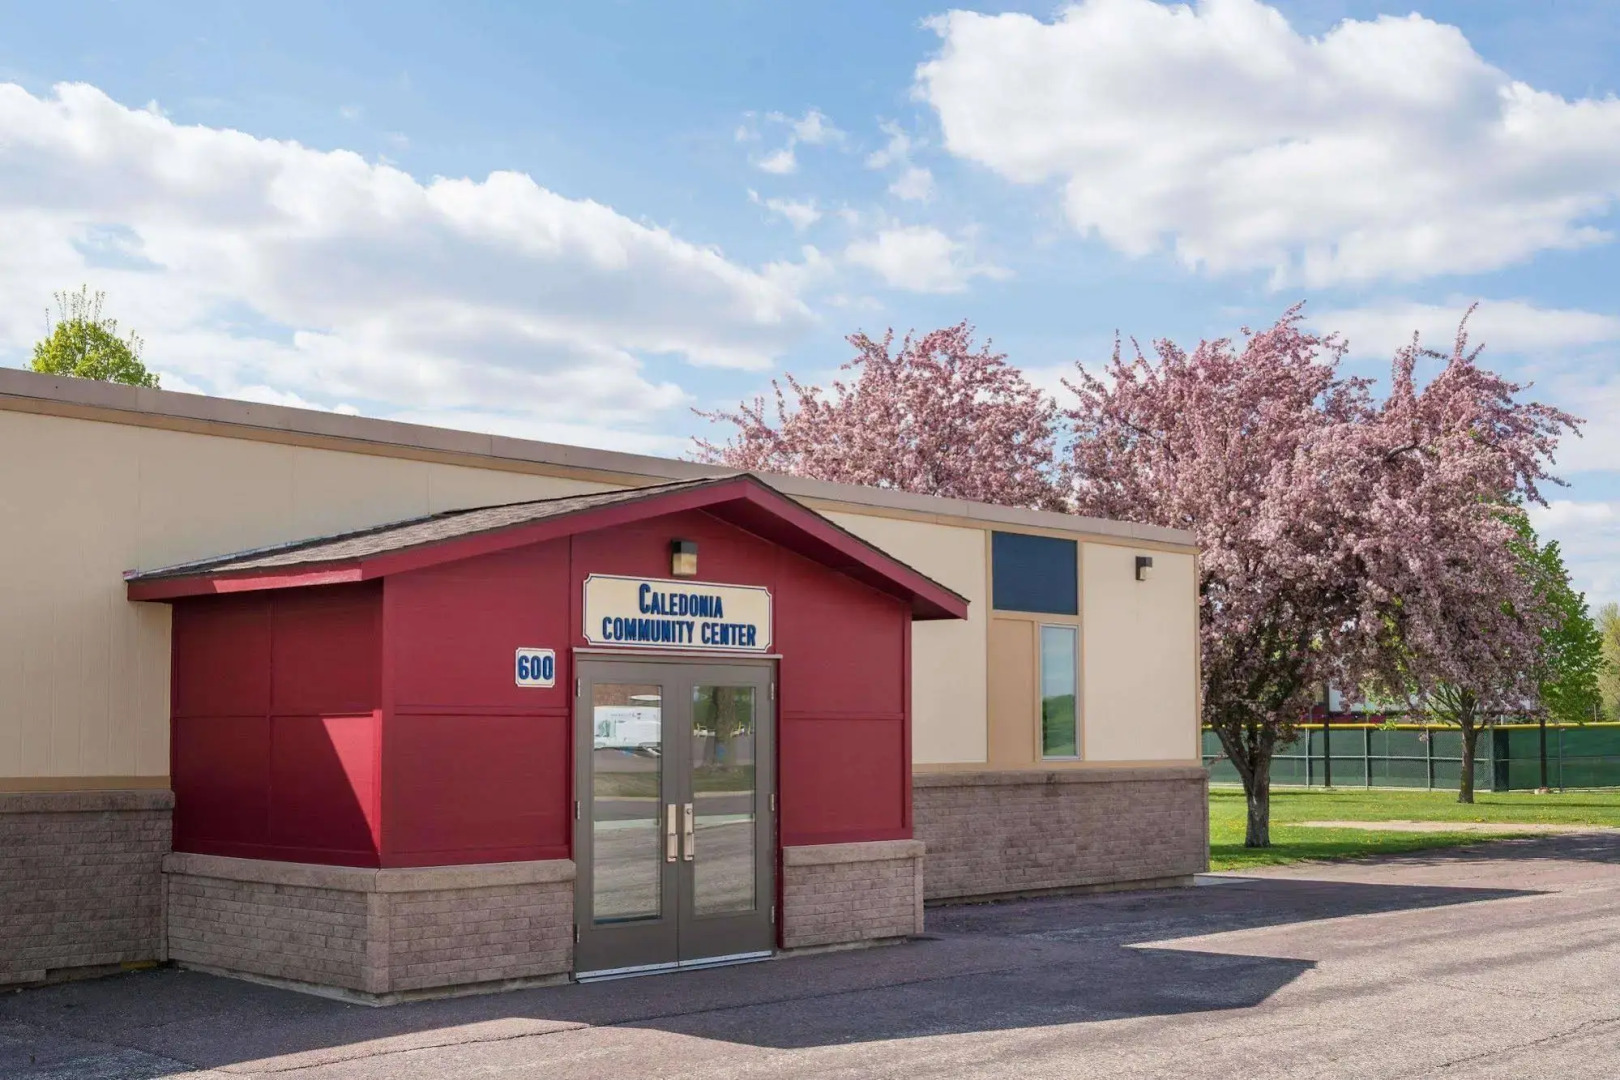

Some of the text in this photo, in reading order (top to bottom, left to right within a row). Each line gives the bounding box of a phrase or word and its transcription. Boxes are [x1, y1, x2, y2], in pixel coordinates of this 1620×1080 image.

[639, 583, 723, 618] CALEDONIA
[602, 617, 756, 647] COMMUNITY CENTER
[518, 655, 553, 680] 600
